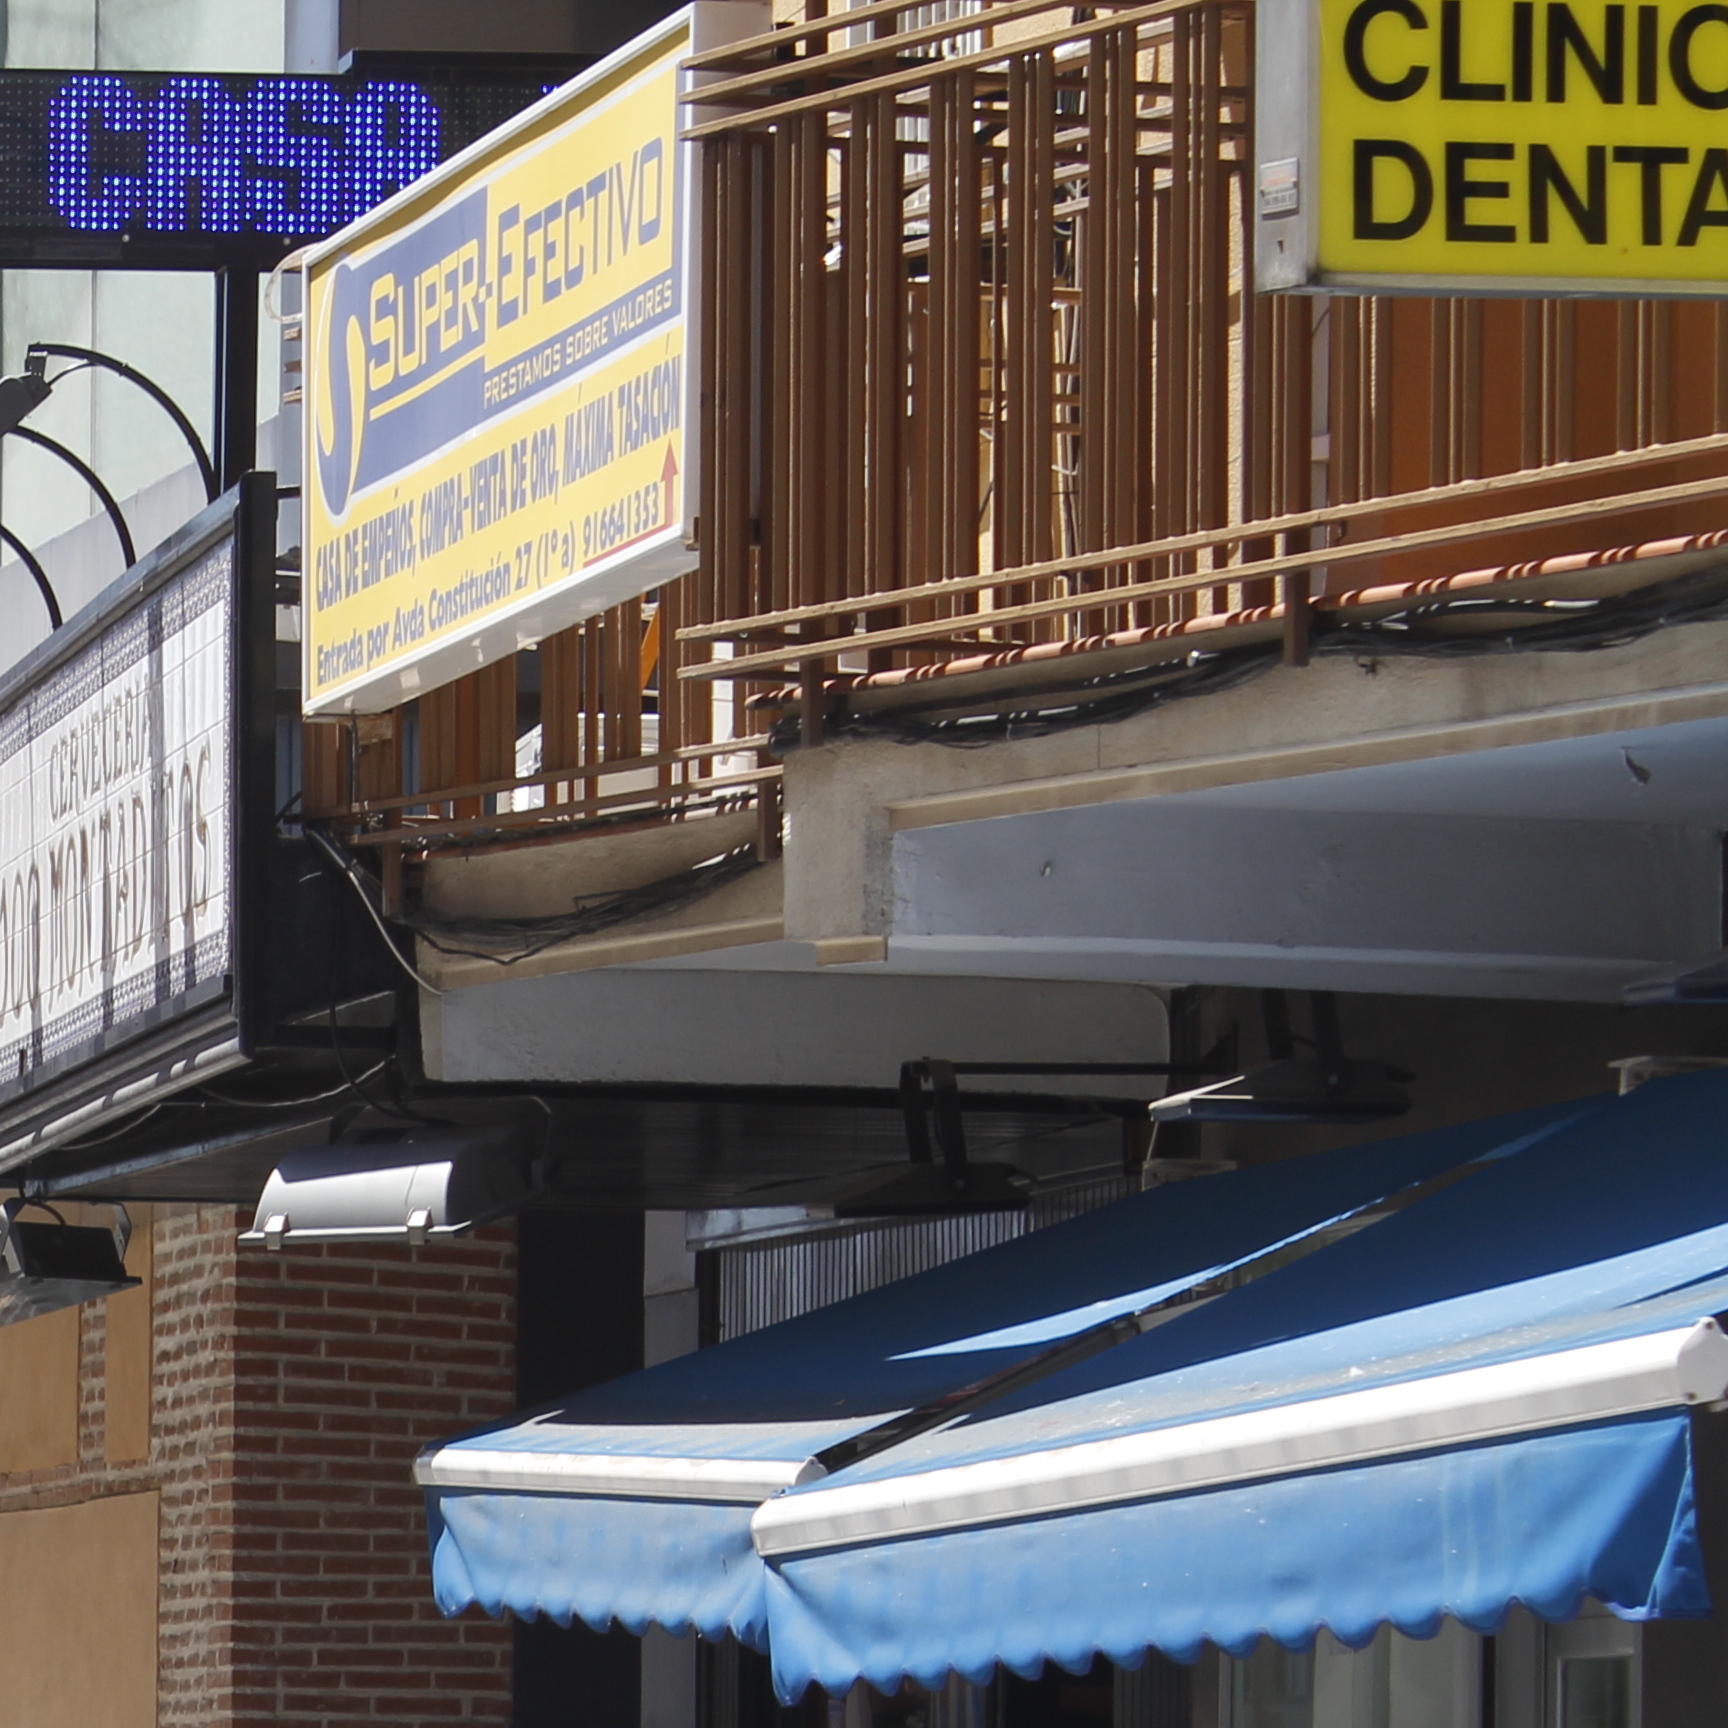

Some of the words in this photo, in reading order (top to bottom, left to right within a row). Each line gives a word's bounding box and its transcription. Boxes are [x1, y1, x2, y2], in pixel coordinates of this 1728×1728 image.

[1343, 0, 1728, 110] CLINIC
[47, 74, 440, 235] CASA
[1352, 139, 1728, 247] DENTA
[483, 343, 562, 409] PRESTAMOS
[565, 316, 609, 366] SOBRE
[612, 278, 673, 338] VALORES
[316, 542, 342, 613] CASA
[345, 526, 360, 599] DE
[511, 437, 528, 517] DE
[562, 383, 614, 487] MÁXIMA
[617, 333, 680, 460] TASACIÓN
[317, 628, 364, 687] Entrada
[366, 621, 390, 671] por
[391, 600, 425, 652] Avda
[428, 551, 511, 632] Constitución
[514, 539, 533, 591] 27
[582, 481, 660, 559] 916641353
